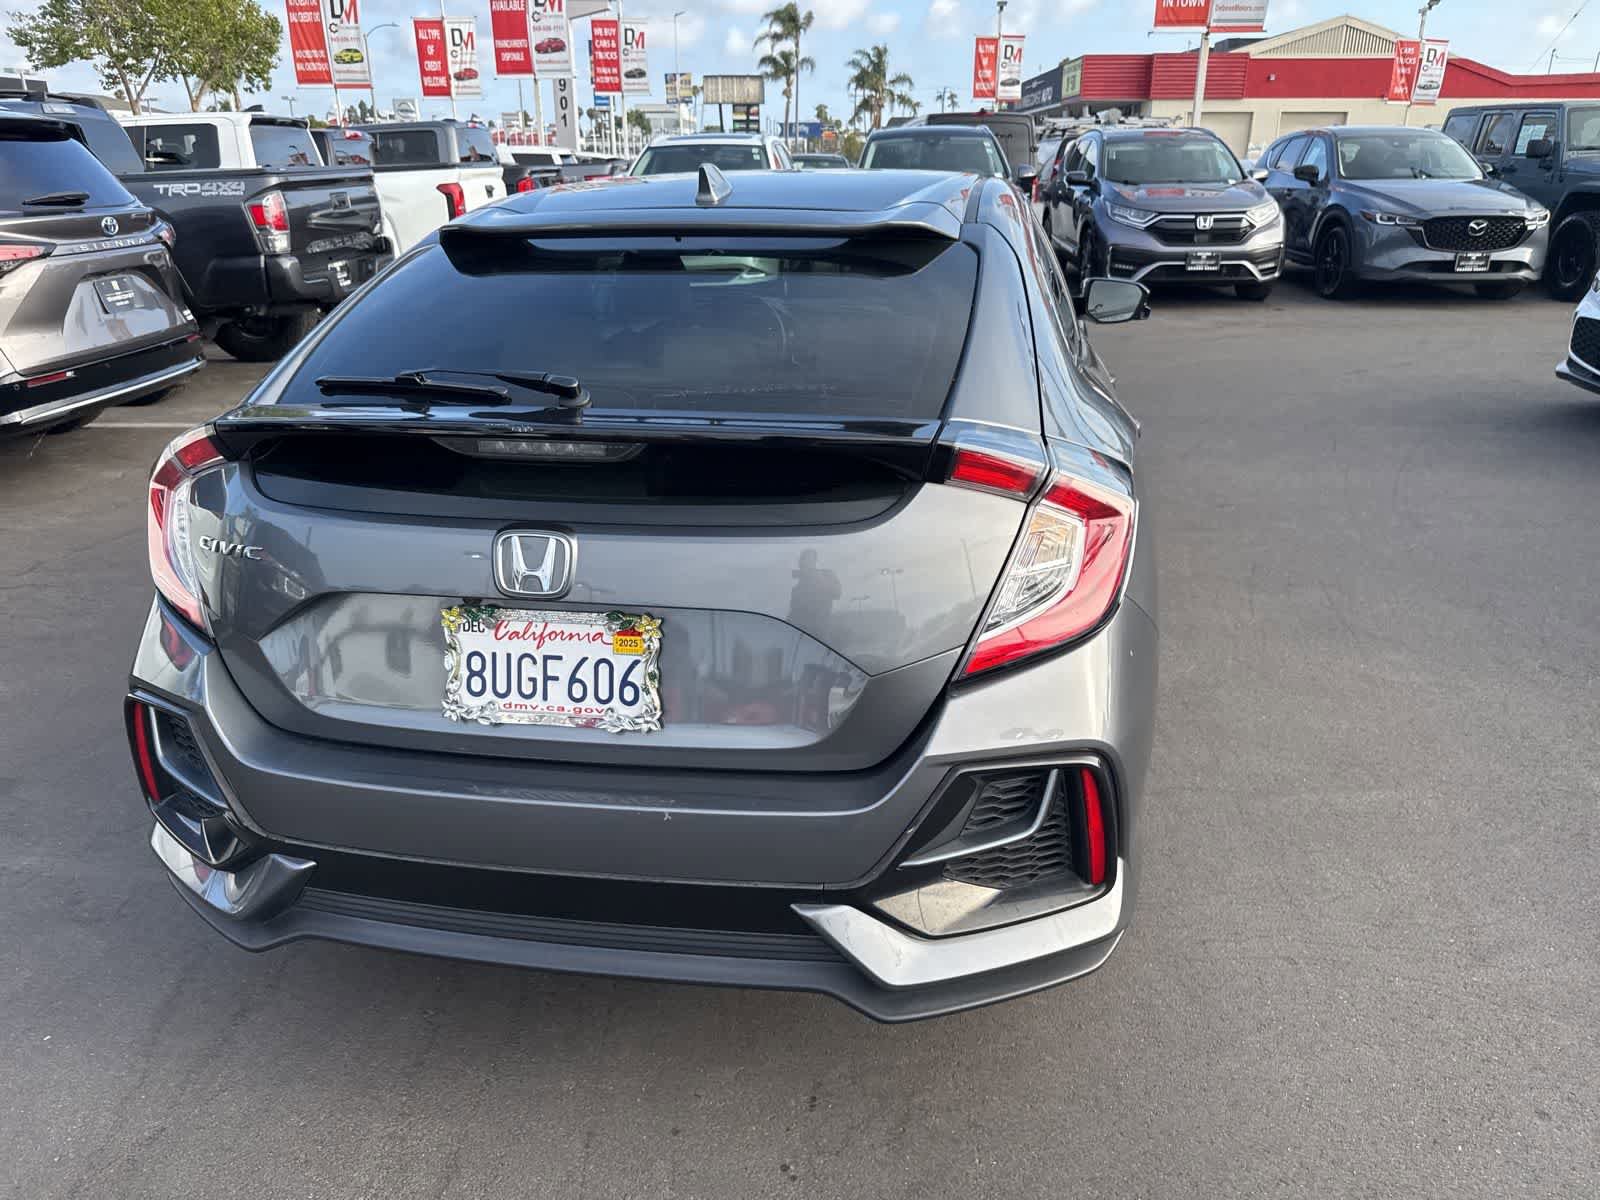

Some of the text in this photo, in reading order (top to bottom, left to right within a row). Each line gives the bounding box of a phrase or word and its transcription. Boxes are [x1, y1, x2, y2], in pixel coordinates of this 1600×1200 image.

[492, 0, 525, 11] AVAILABLE
[428, 29, 440, 40] TYPE
[153, 182, 201, 197] TRD
[79, 237, 147, 252] SIENNA
[199, 535, 264, 560] CIVIC
[462, 619, 613, 650] DEC California
[618, 638, 639, 648] 2025
[466, 650, 644, 707] 8UGF606
[503, 701, 605, 715] dmv.ca.gov
